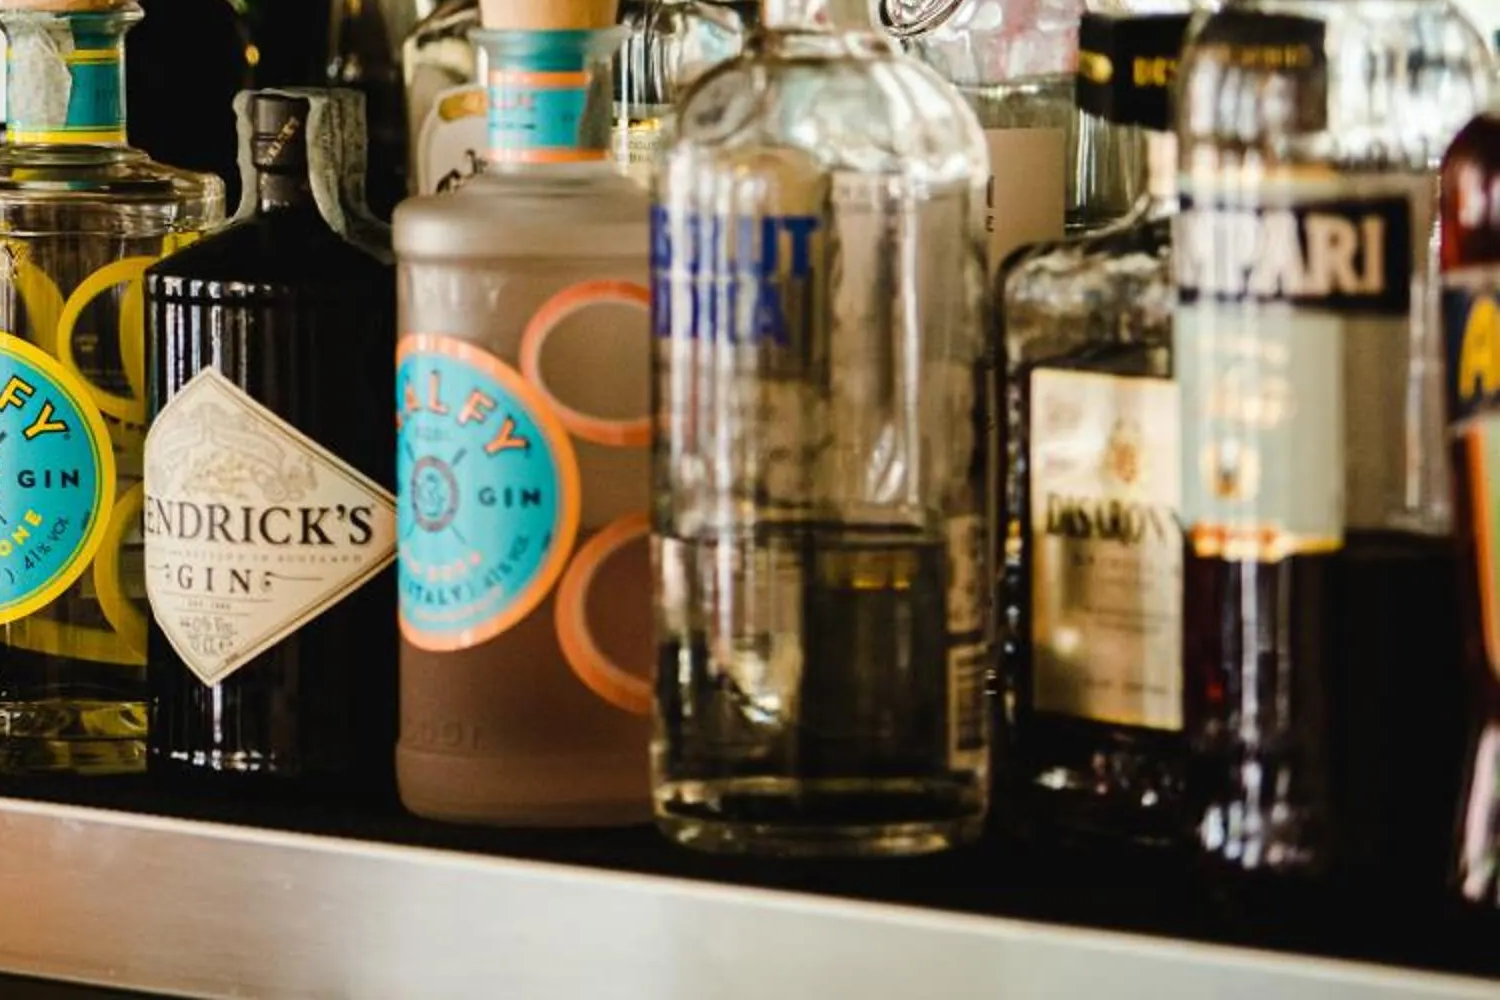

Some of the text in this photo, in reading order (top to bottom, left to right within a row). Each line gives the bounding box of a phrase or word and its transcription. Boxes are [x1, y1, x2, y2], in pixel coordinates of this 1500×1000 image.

[397, 368, 533, 457] ALFY
[17, 469, 80, 489] GIN
[478, 485, 543, 510] GIN
[176, 563, 253, 594] GIN
